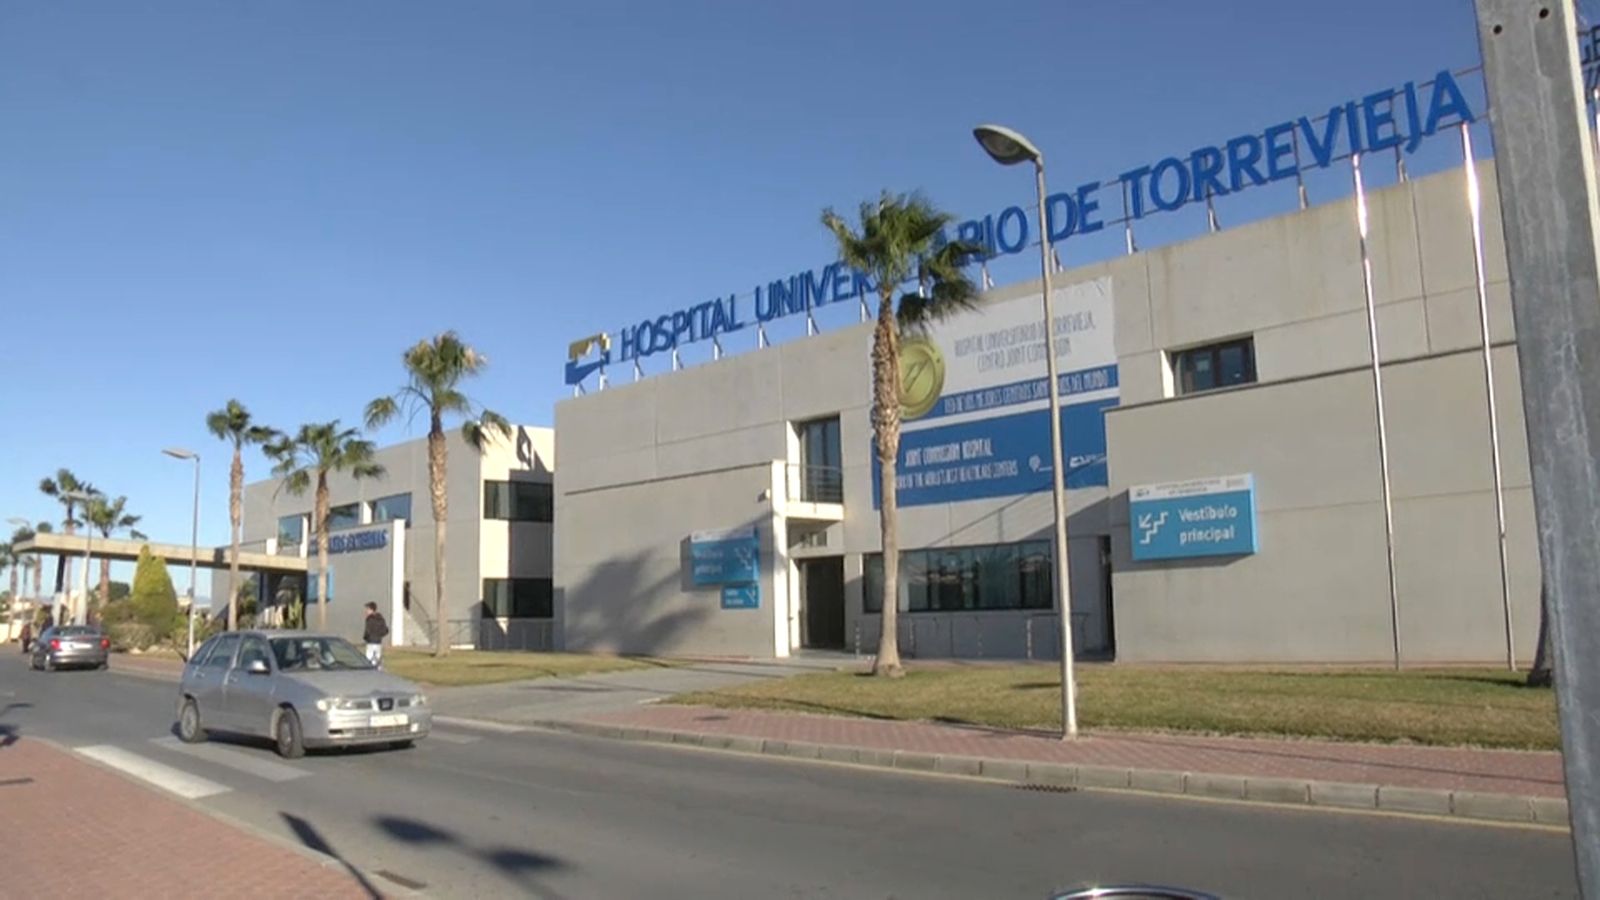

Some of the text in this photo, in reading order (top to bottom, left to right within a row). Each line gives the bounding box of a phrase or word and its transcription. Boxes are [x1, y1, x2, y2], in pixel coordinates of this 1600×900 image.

[620, 69, 1475, 362] HOSPITAL UNIVERRIO DE TORREVIEJA
[1178, 504, 1238, 522] Vestíbulo
[1179, 525, 1235, 546] principal
